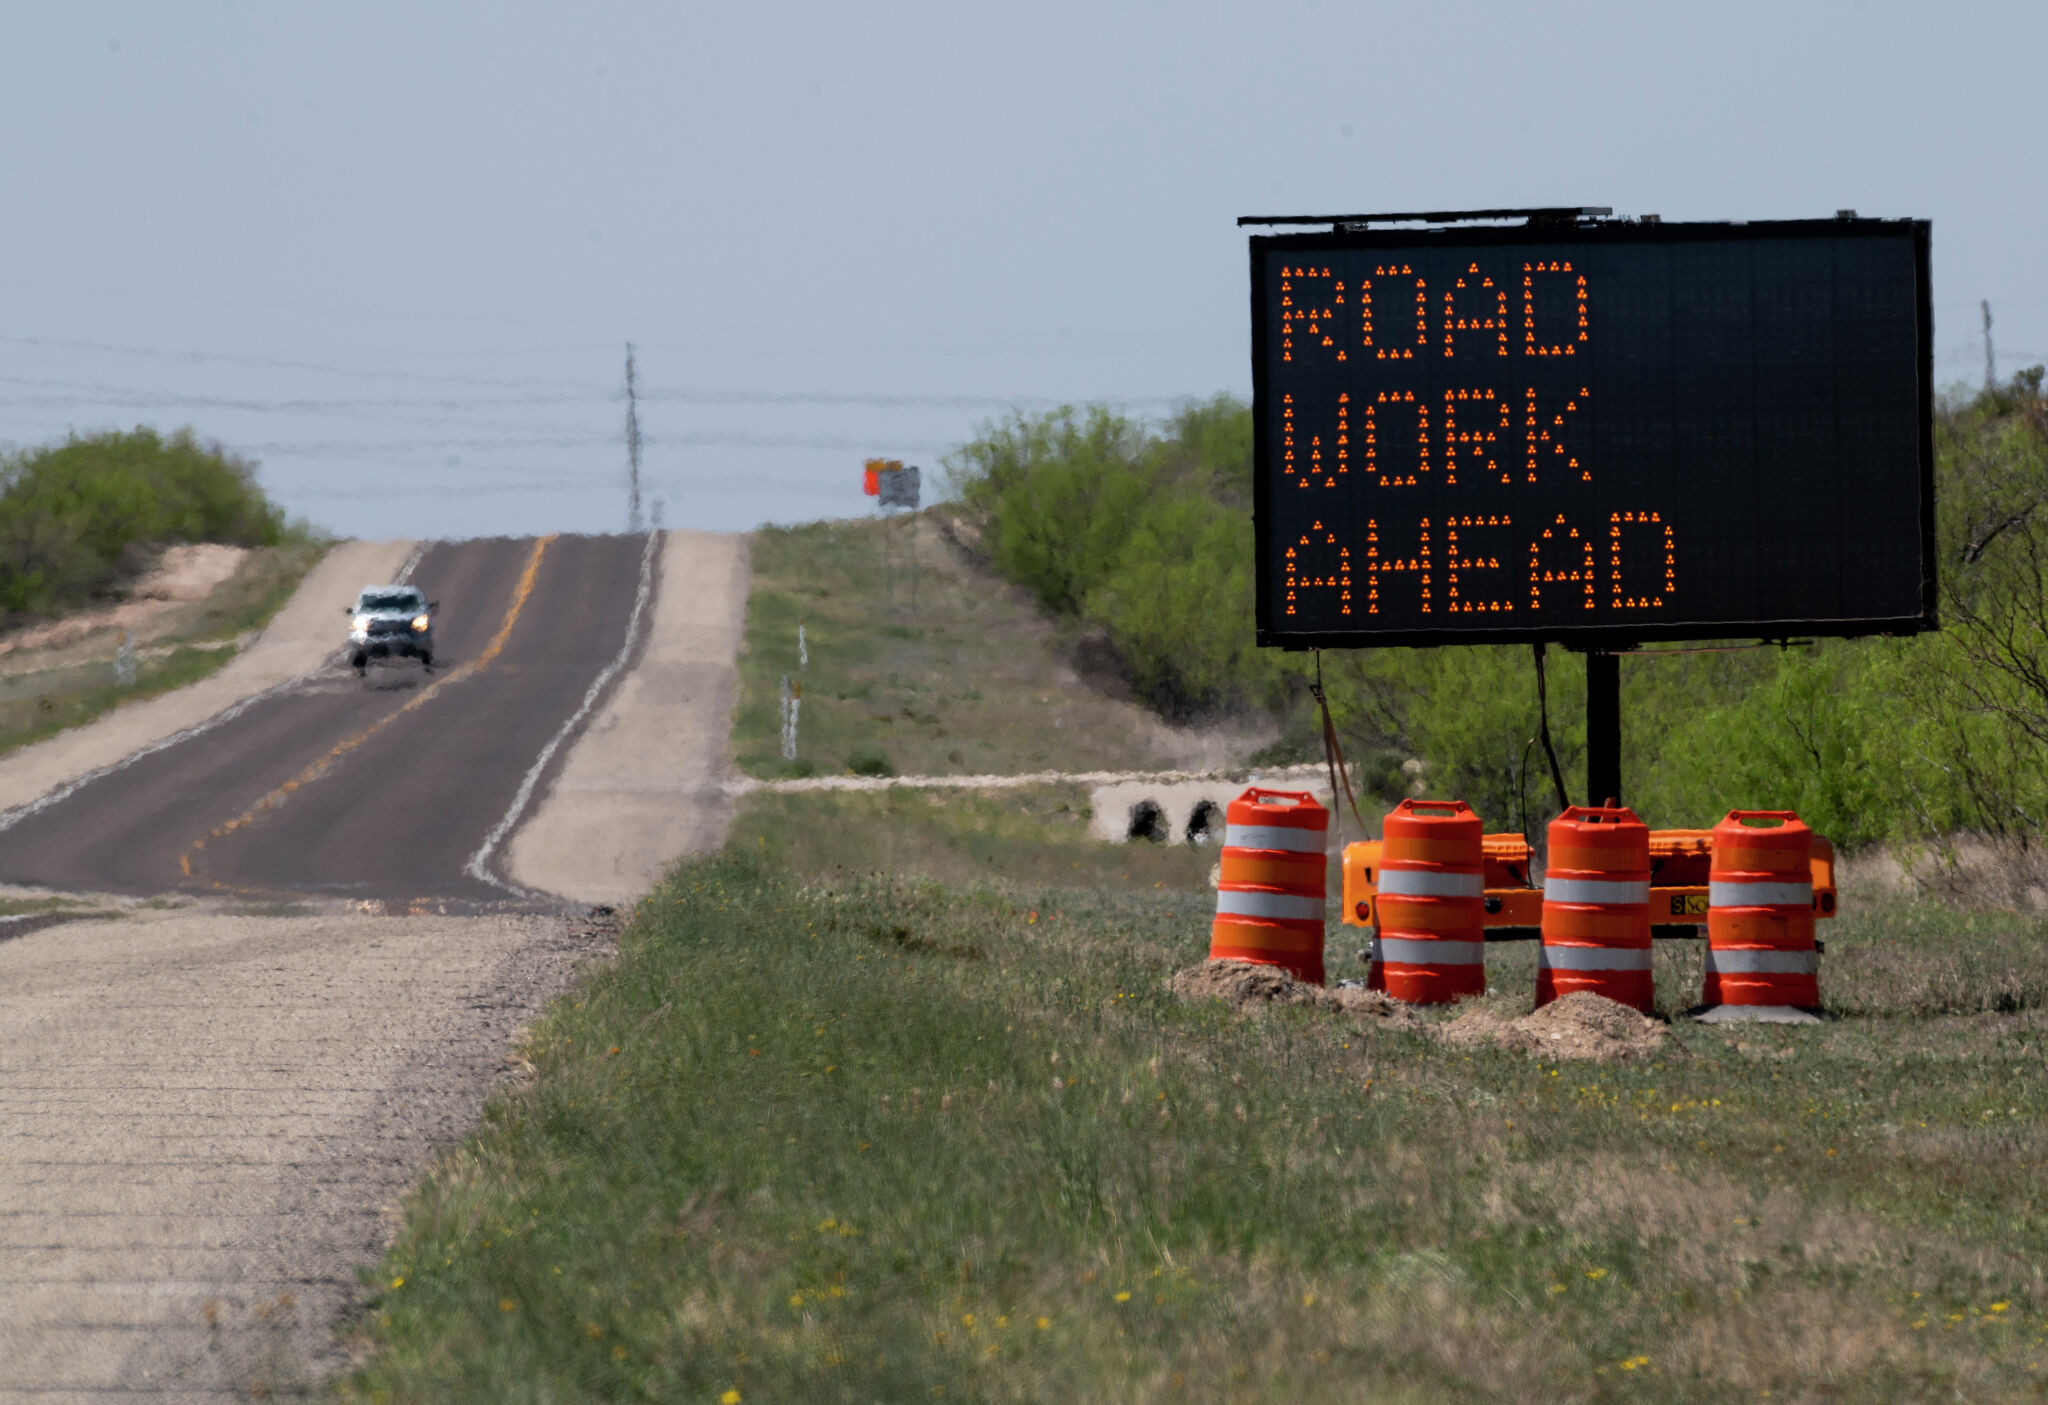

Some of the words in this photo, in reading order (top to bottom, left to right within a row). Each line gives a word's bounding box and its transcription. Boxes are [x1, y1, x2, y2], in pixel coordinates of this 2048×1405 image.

[1282, 262, 1588, 361] ROAD
[1284, 388, 1592, 488] WORK
[1286, 511, 1675, 615] AHEAD
